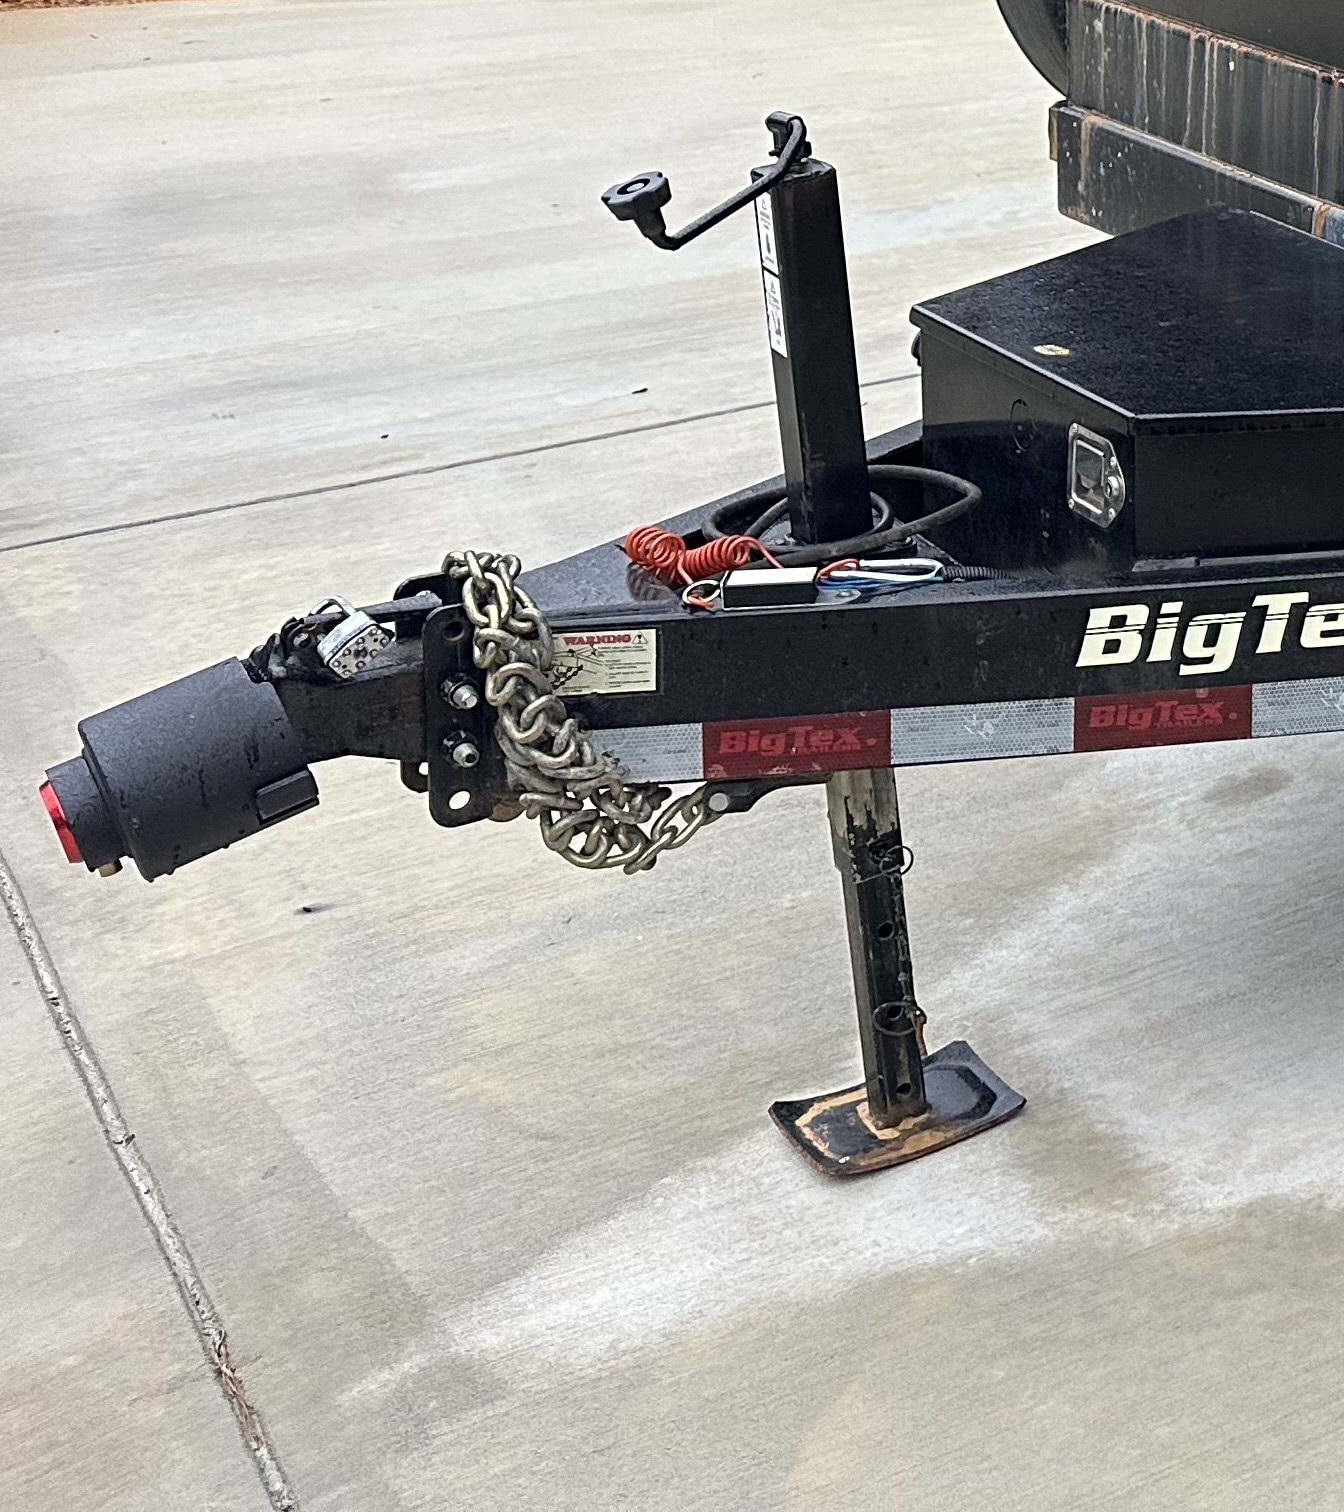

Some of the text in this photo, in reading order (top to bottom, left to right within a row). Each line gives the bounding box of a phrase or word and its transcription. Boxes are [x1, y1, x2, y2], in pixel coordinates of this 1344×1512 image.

[562, 634, 631, 646] WARNING
[1089, 700, 1225, 730] BigTex
[719, 726, 862, 757] BigTex
